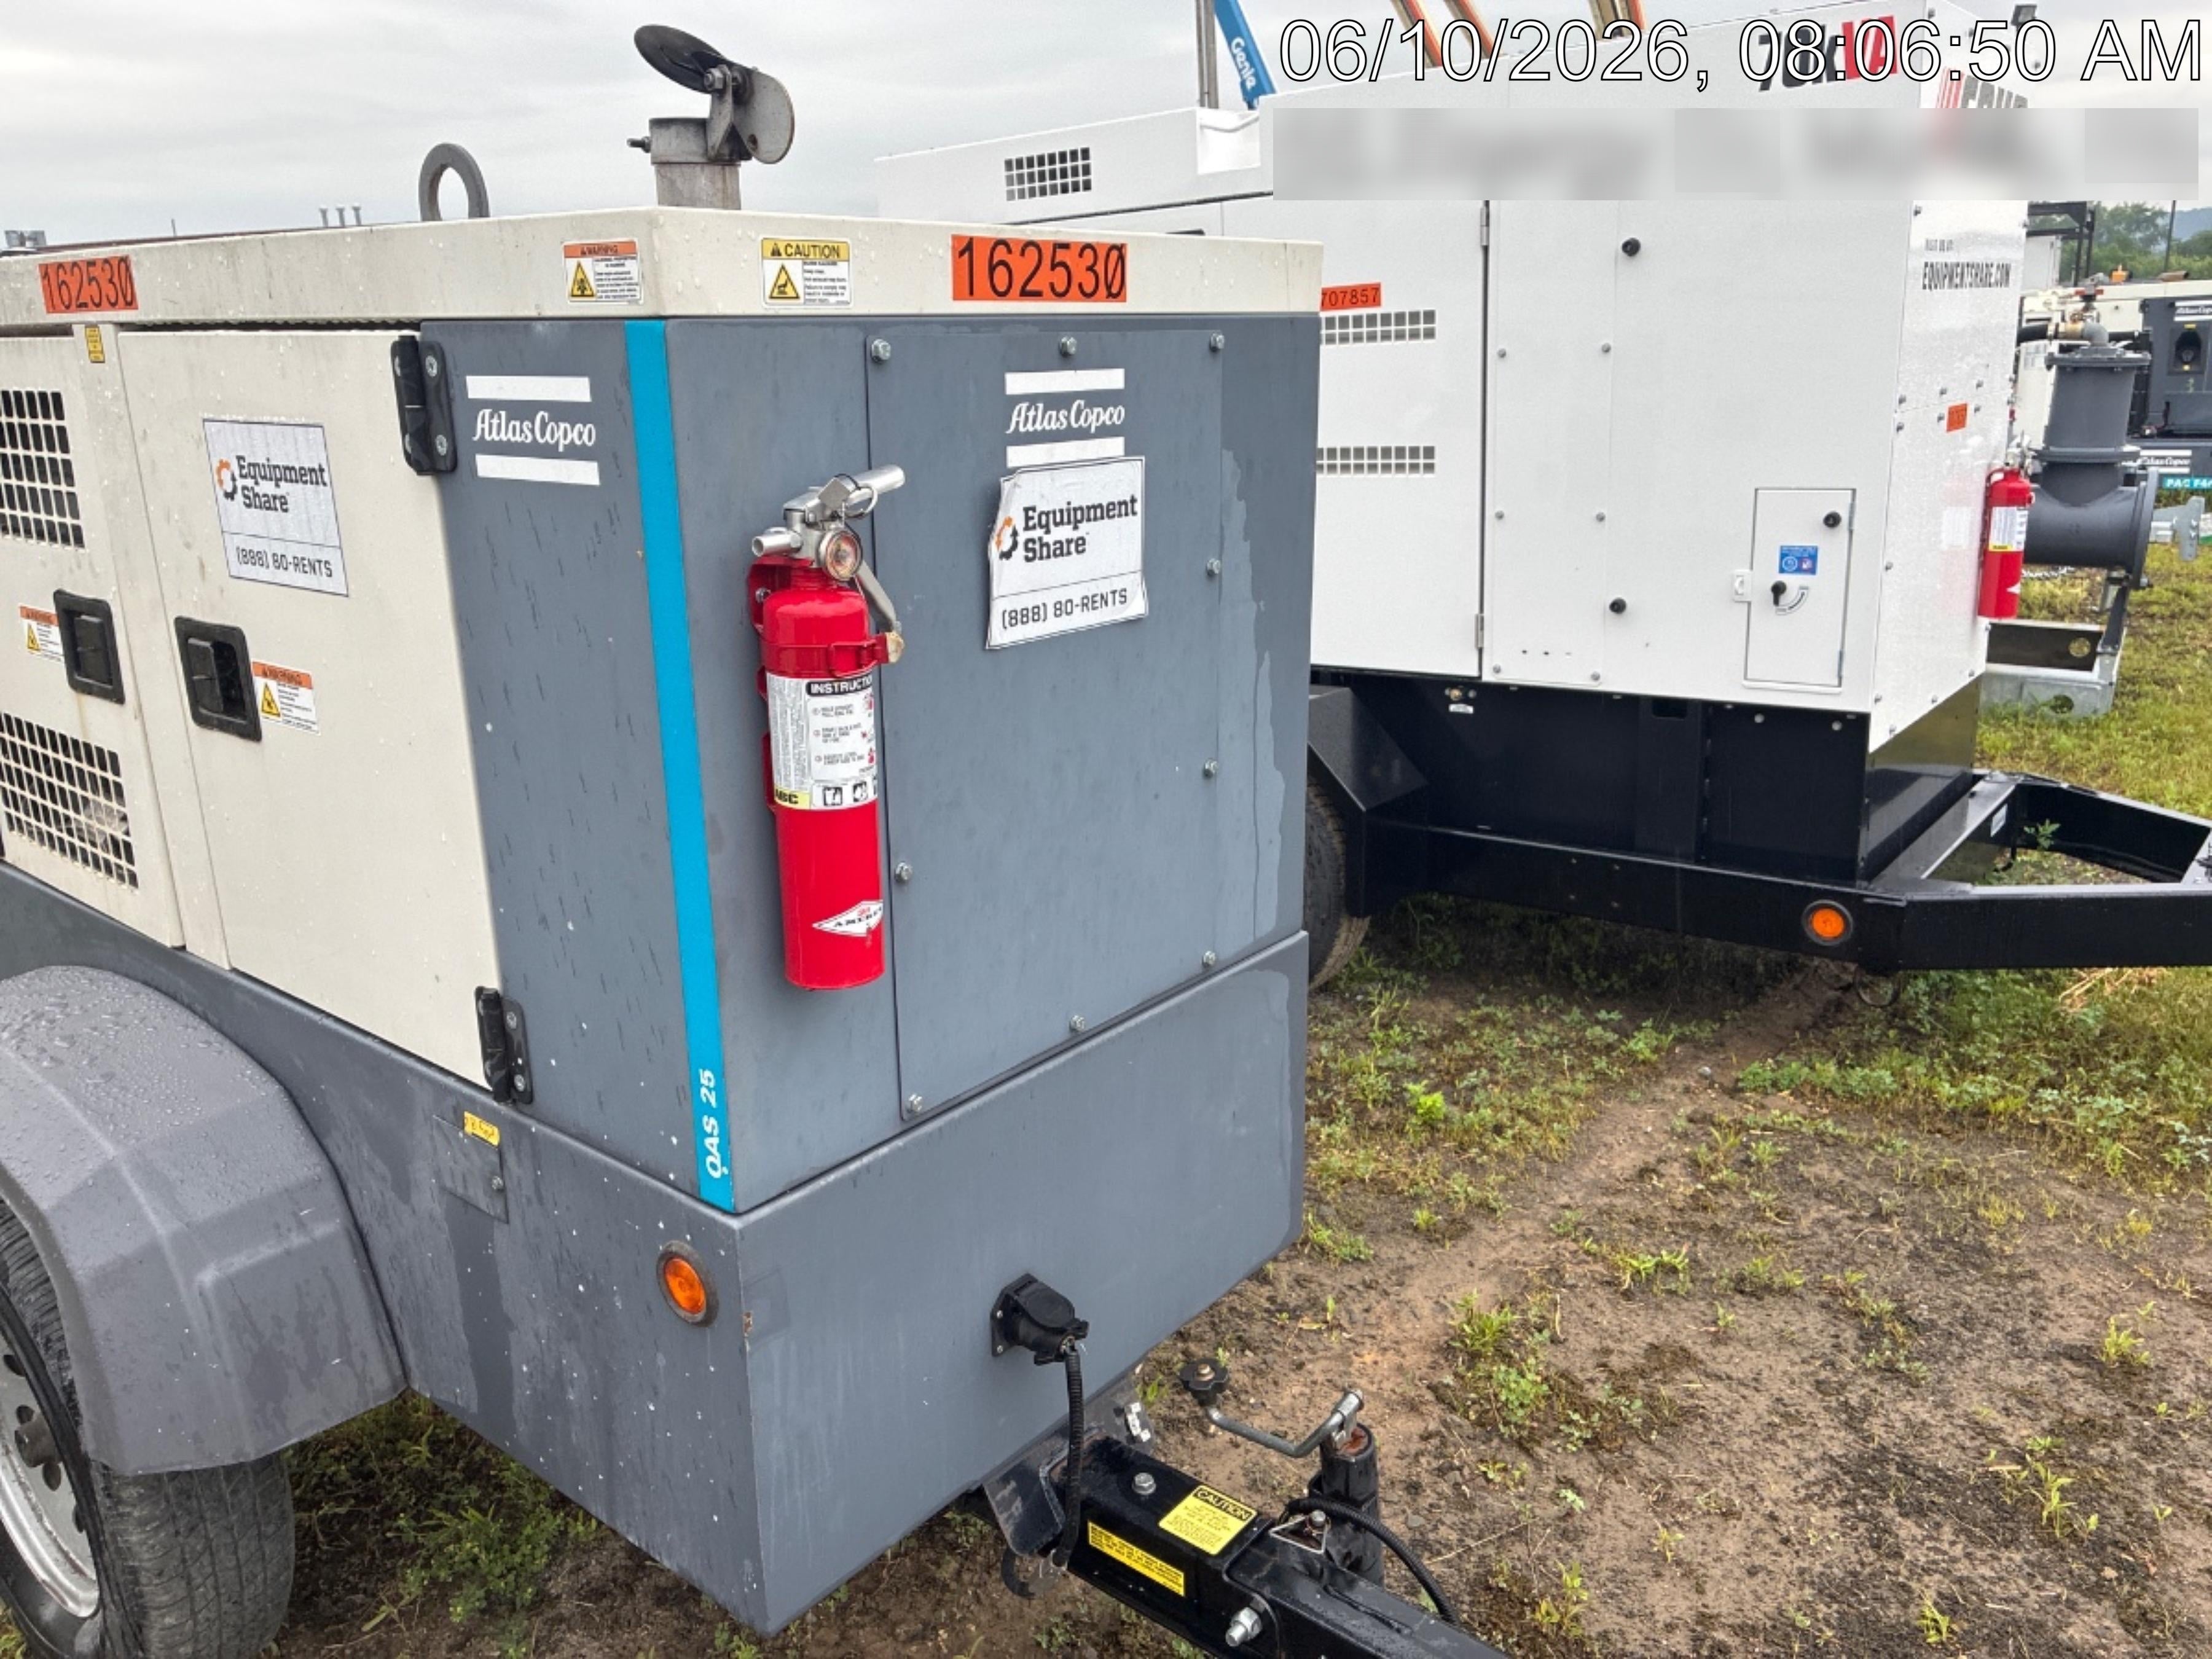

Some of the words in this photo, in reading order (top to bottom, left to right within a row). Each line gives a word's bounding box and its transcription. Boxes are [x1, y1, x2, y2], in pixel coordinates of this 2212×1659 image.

[1231, 37, 1257, 90] Genie
[784, 243, 841, 258] CAUTION
[958, 237, 1125, 299] 162530
[39, 255, 133, 310] 162530
[471, 408, 533, 444] Atlas
[534, 410, 596, 452] Copco
[1005, 401, 1068, 434] Atlas
[1070, 399, 1125, 434] Copco
[236, 455, 328, 488] Equipment
[241, 484, 289, 512] Share
[1022, 493, 1138, 535] Equipment
[236, 546, 270, 570] (888)
[271, 552, 333, 578] 80-RENTS
[1022, 532, 1087, 563] Share
[1002, 602, 1047, 630] (888)
[1053, 587, 1128, 619] 80-RENTS
[699, 1069, 716, 1108] 25
[702, 1115, 728, 1179] QAS
[1197, 1491, 1251, 1520] CAUTION
